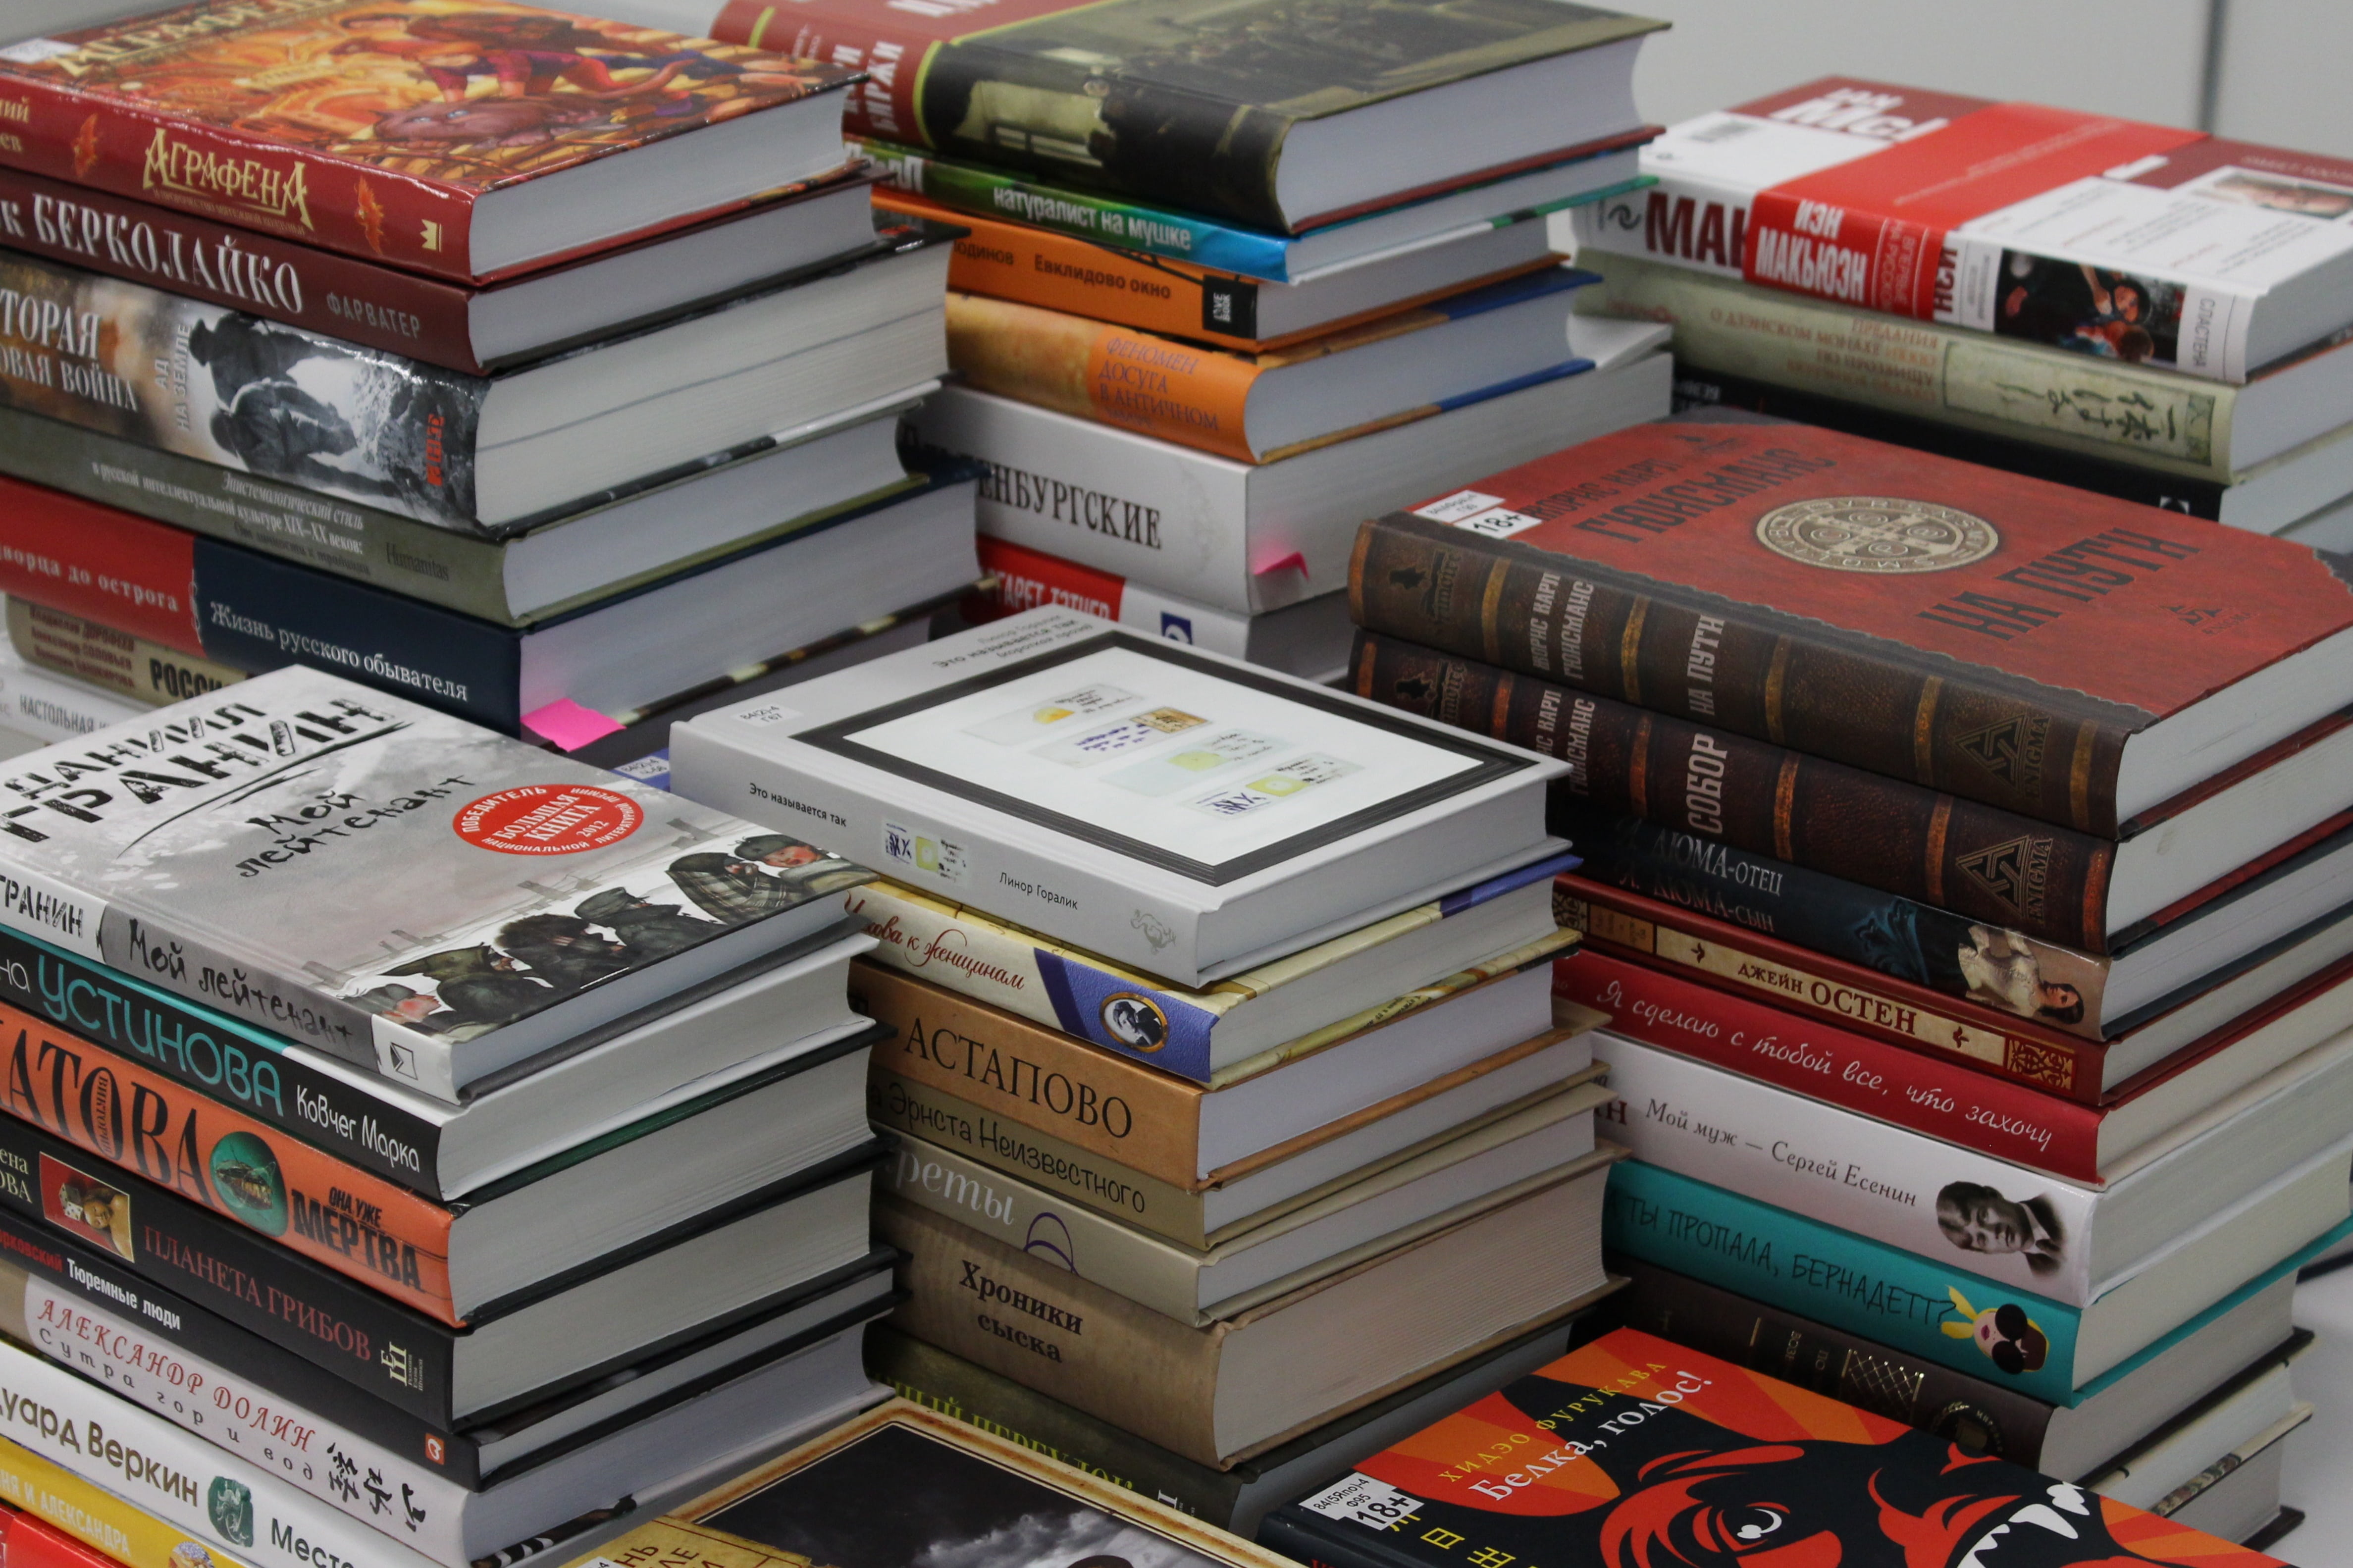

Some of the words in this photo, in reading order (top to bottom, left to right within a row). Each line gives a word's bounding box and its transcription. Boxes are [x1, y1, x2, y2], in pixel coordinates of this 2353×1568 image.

[143, 128, 314, 232] АГРАФЕНА
[993, 185, 1098, 228] натуралист
[1101, 211, 1124, 236] на
[1129, 216, 1192, 252] мушке
[1794, 199, 1844, 241] ИЭН
[33, 193, 304, 313] БЕРКОЛАЙКО
[1034, 254, 1127, 290] Евклидово
[1131, 277, 1172, 300] окно
[1756, 227, 1868, 303] МАКЬЮЭН
[327, 292, 420, 339] ФАРВАТЕР
[2194, 299, 2216, 367] СЛАСТЕНА
[59, 359, 139, 413] ВОЙНА
[154, 356, 170, 390] АД
[172, 323, 193, 395] ЗЕМЛЕ
[1098, 359, 1168, 395] ДОСУГА
[1106, 336, 1199, 375] ФЕНОМЕН
[177, 397, 191, 431] НА
[1100, 383, 1110, 403] В
[1113, 387, 1218, 431] АНТИЧНОМ
[101, 464, 139, 488] русской
[143, 476, 235, 516] интеллектуальной
[237, 505, 281, 533] культуре
[223, 470, 331, 522] Эпистемологический
[333, 505, 364, 530] стиль
[1474, 511, 1522, 534] 18+
[0, 547, 60, 577] ворца
[68, 566, 91, 585] до
[99, 573, 180, 614] острога
[385, 541, 450, 582] Humanitas
[1538, 572, 1562, 617] КАРЛ
[1916, 590, 2064, 642] НА
[1996, 527, 2202, 603] ПУТИ
[210, 600, 275, 641] Жизнь
[278, 626, 360, 668] русского
[364, 652, 469, 702] обывателя
[1560, 579, 1595, 680] ГЮИСМАНС
[1686, 614, 1726, 684] ПУТИ
[20, 694, 95, 733] НАСТОЛЬНАЯ
[1537, 689, 1562, 733] КАРЛ
[1689, 688, 1716, 717] НА
[0, 698, 396, 843] ГРАНИН
[4, 702, 267, 801] ДАНИИЛ
[1686, 733, 1730, 835] СОБОР
[235, 774, 475, 878] лейтенант
[245, 789, 367, 835] Мой
[462, 786, 548, 834] ПОБЕДИТЕЛЬ
[491, 793, 581, 841] БОЛЬШАЯ
[523, 803, 602, 842] КНИГА
[570, 786, 623, 803] ПРЕМИИ
[596, 801, 636, 844] ЛИТЕРАТУРНОЙ
[749, 782, 769, 799] Это
[771, 792, 828, 822] называется
[828, 812, 848, 828] так
[481, 836, 590, 853] НАЦИОНАЛЬНОЙ
[575, 820, 610, 839] 2012
[998, 871, 1034, 897] Линор
[1036, 885, 1079, 910] Горалик
[1651, 831, 1784, 896] ДЮМА-ОТЕЦ
[2028, 837, 2053, 925] ENIGMA
[1651, 872, 1776, 935] ДЮМА-СЫН
[904, 929, 1026, 991] женщинам
[907, 935, 921, 952] к
[129, 918, 187, 984] Мой
[198, 966, 354, 1050] лейтенант
[1737, 963, 1804, 995] ДЖЕЙН
[1809, 980, 1918, 1037] ОСТЕН
[39, 954, 285, 1117] УСТИНОВА
[362, 1113, 421, 1174] Марка
[904, 1017, 1133, 1139] АСТАПОВО
[1596, 980, 1623, 1009] Я
[1632, 998, 1720, 1039] сделаю
[1730, 1029, 1744, 1049] с
[1753, 1033, 1833, 1076] тобой
[1841, 1059, 1889, 1097] все,
[1905, 1083, 1956, 1115] что
[1964, 1103, 2054, 1153] захочу
[0, 1020, 219, 1210] АТОВА
[890, 1081, 973, 1144] Эрнста
[980, 1116, 1146, 1215] Неизвестного
[1645, 1097, 1689, 1134] Мой
[1693, 1120, 1739, 1148] муж
[1771, 1140, 1839, 1183] Сергей
[1842, 1164, 1918, 1208] Есенин
[291, 1189, 425, 1292] МЕРТВА
[328, 1186, 353, 1210] ОНА
[354, 1198, 383, 1229] УЖЕ
[67, 1258, 138, 1309] Тюремные
[142, 1298, 181, 1331] люди
[144, 1224, 263, 1308] ПЛАНЕТА
[266, 1283, 372, 1363] ГРИБОВ
[1626, 1195, 1659, 1229] ТЫ
[1667, 1211, 1780, 1278] ПРОПАЛА,
[1791, 1253, 1958, 1328] БЕРНАДЕТТ?
[958, 1258, 1084, 1336] Хроники
[977, 1309, 1064, 1364] сыска
[38, 1299, 206, 1395] АЛЕКСАНДР
[213, 1386, 317, 1453] ДОЛИН
[39, 1327, 135, 1389] Сутра
[157, 1392, 205, 1426] гор
[226, 1426, 242, 1445] и
[263, 1447, 314, 1481] вод
[0, 1388, 81, 1454] уард
[88, 1420, 198, 1507] Веркин
[1439, 1432, 1532, 1484] ХИДЭО
[1535, 1359, 1668, 1432] ФУРУКАВА
[1468, 1436, 1608, 1502] Белка,
[1602, 1369, 1713, 1437] голос!
[24, 1481, 36, 1506] И
[41, 1489, 132, 1557] АЛЕКСАНДРА
[1313, 1477, 1371, 1511] 84(5Япо)-4
[1346, 1493, 1372, 1509] Ф95
[1356, 1494, 1412, 1525] 18+
